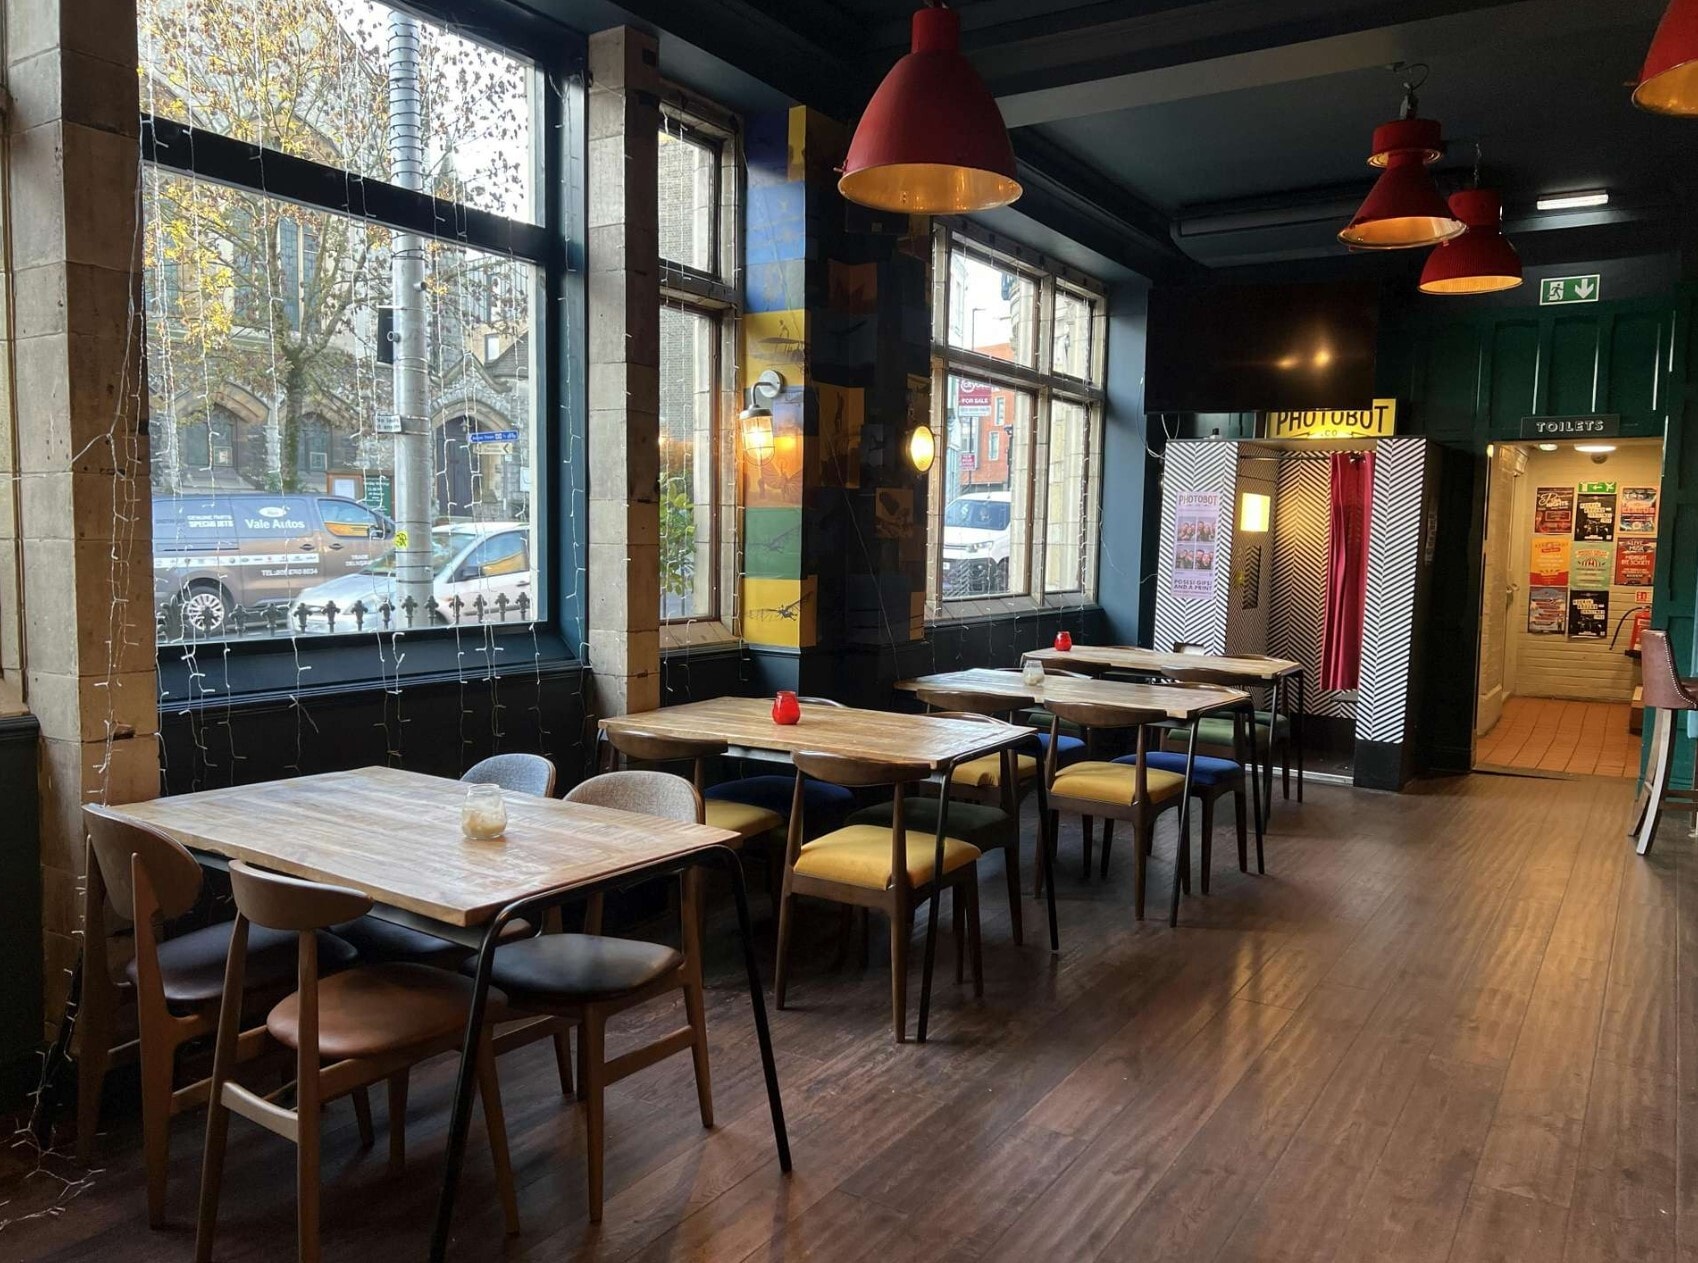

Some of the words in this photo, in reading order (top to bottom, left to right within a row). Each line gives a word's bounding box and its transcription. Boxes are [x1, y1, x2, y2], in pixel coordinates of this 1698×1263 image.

[961, 397, 974, 405] FOR
[1276, 405, 1389, 435] PHOTOBOT
[1535, 420, 1605, 433] TOILETS
[1178, 494, 1218, 506] PHOTOBOT
[244, 518, 271, 529] Vale
[272, 518, 306, 529] Autos
